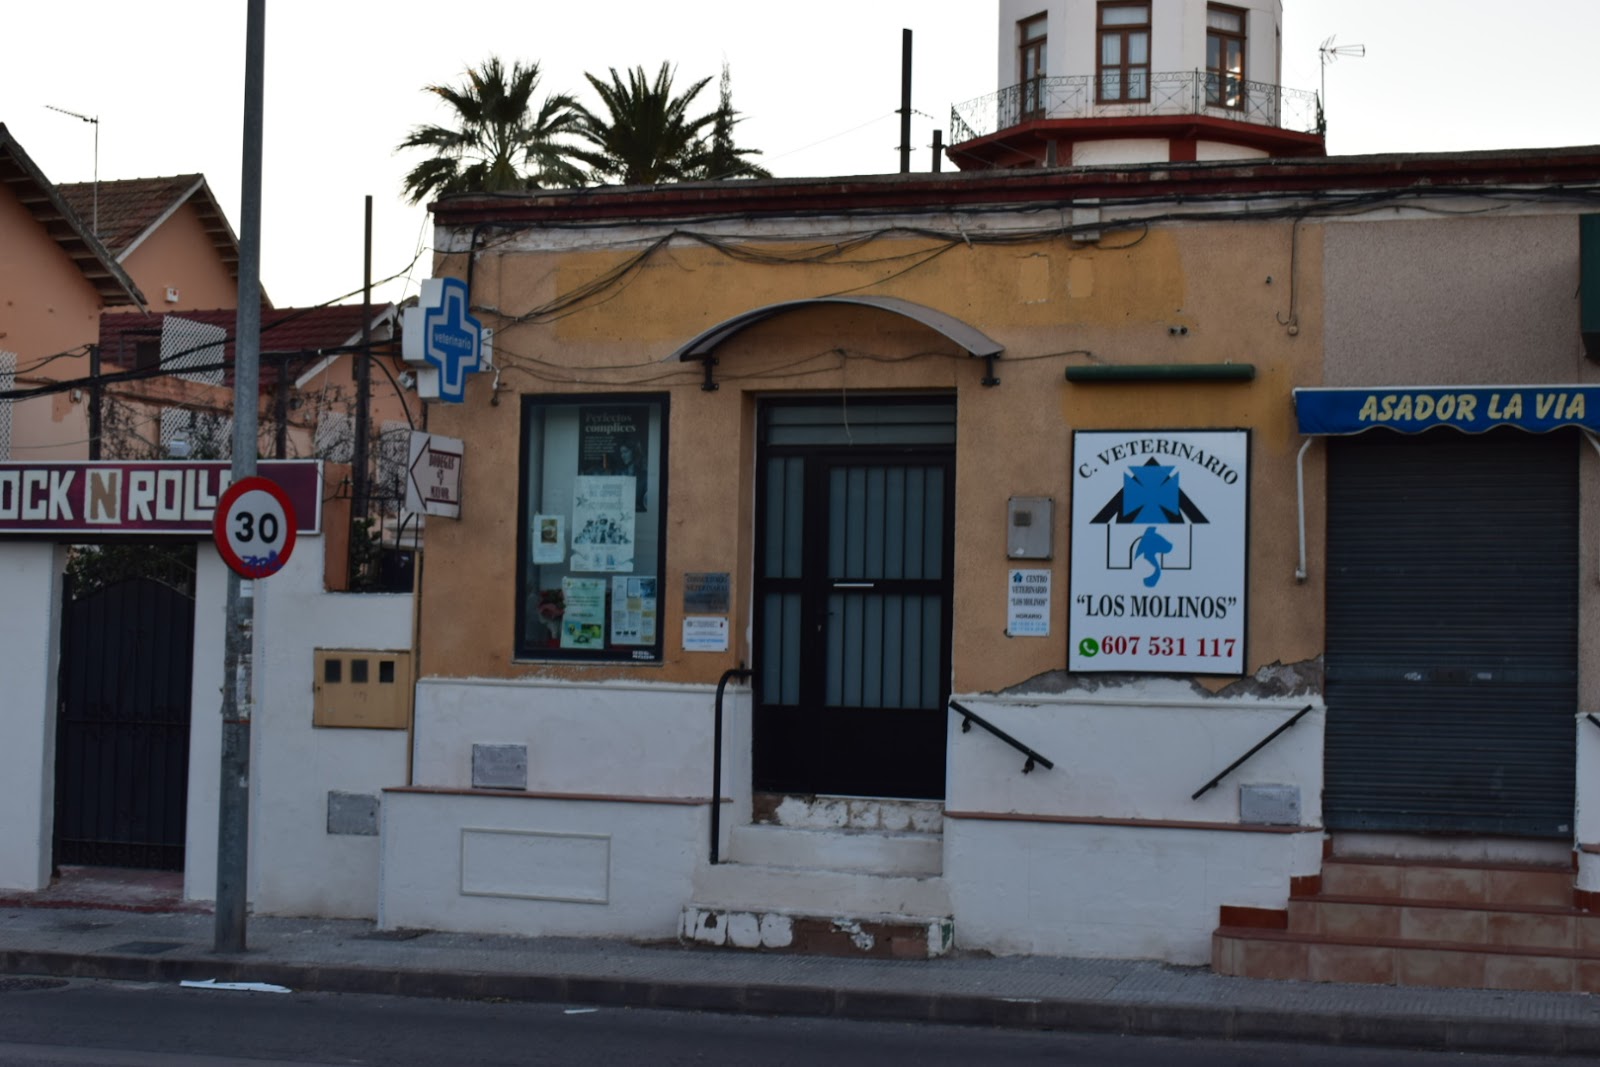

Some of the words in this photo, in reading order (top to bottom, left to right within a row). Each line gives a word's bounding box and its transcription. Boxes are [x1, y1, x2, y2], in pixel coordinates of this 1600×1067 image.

[434, 332, 472, 351] veterinario
[1358, 395, 1477, 422] ASADOR
[1487, 394, 1523, 419] LA
[1535, 393, 1586, 420] VIA
[1078, 463, 1099, 480] C.
[1097, 438, 1239, 486] VETERINARIO
[88, 470, 121, 523] N
[235, 511, 279, 543] 30
[1012, 585, 1048, 594] VETERINARIO
[1025, 574, 1048, 584] CENTRO
[1101, 635, 1141, 656] 607
[1147, 636, 1188, 657] 531
[1196, 637, 1237, 658] 117
